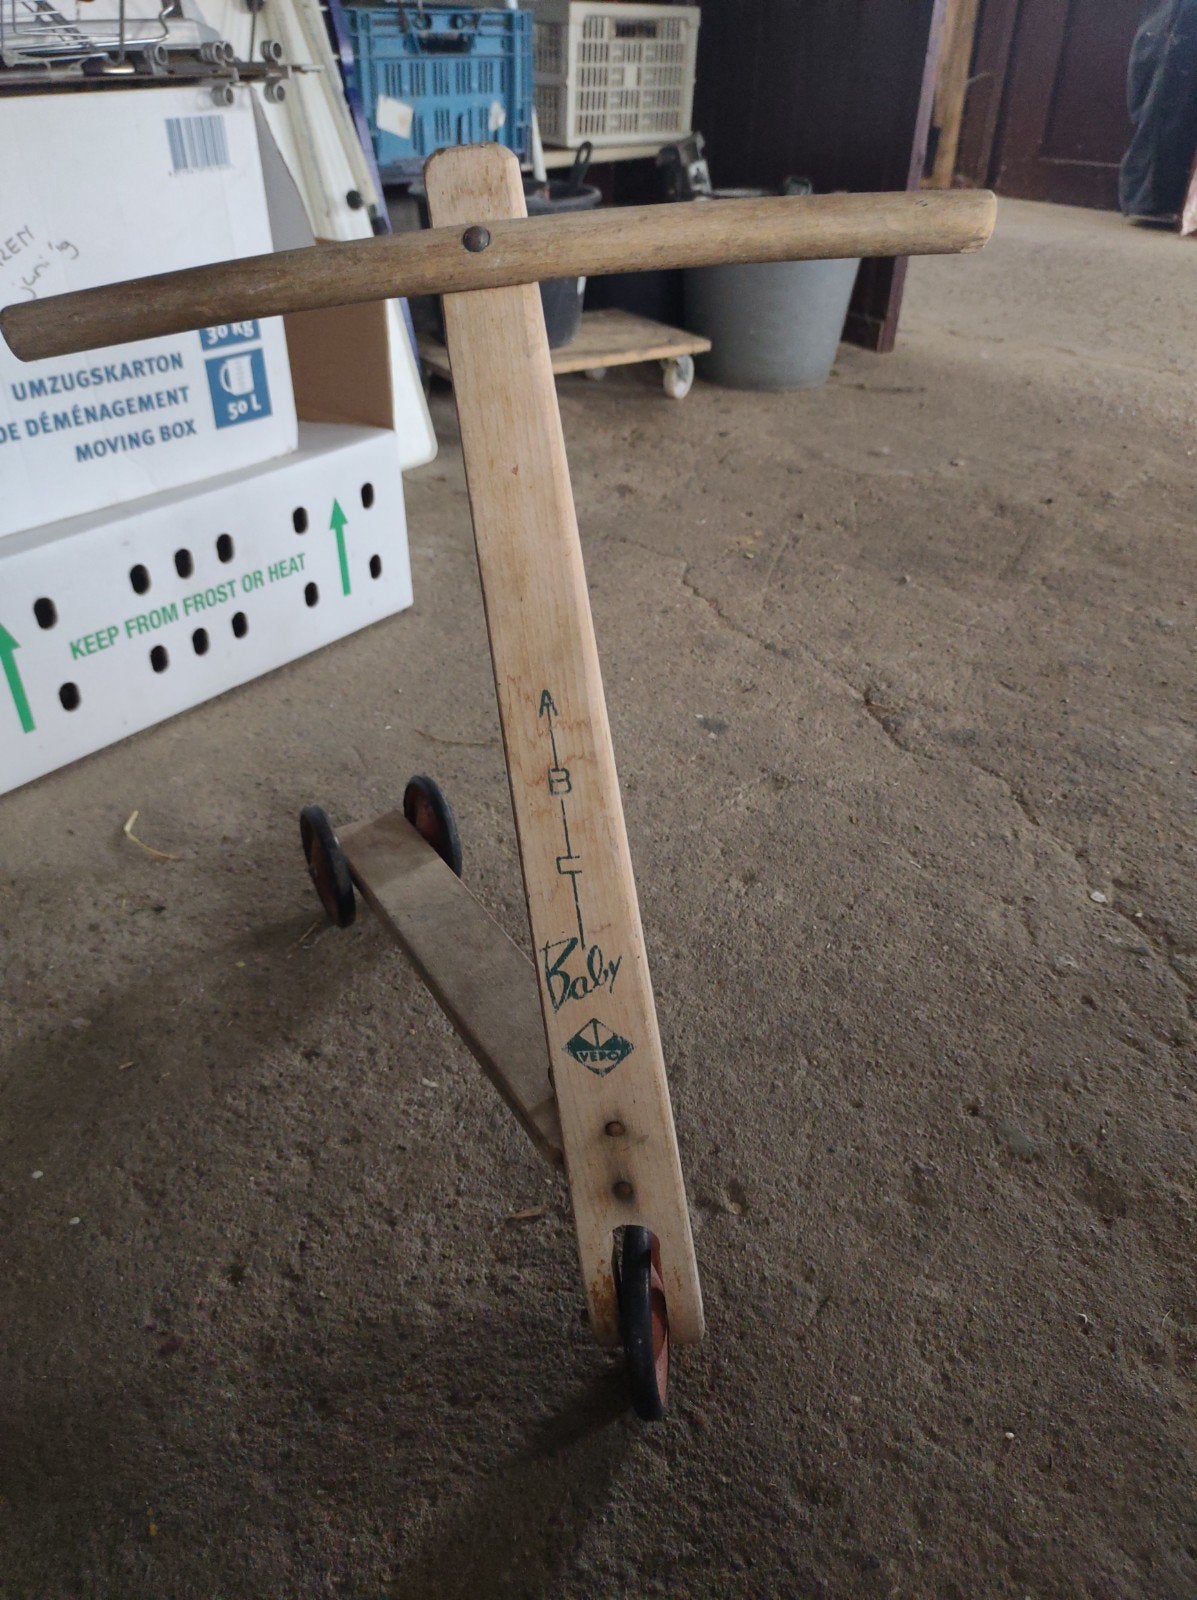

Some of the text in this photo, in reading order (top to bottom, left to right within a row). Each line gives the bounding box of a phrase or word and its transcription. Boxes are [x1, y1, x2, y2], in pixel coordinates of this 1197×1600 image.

[206, 324, 229, 345] 30
[11, 352, 184, 402] UMZUGSKARTON
[24, 385, 190, 438] DÉMÉNAGEMENT
[227, 394, 262, 421] 50 L
[74, 418, 198, 463] MOVING BOX
[69, 552, 307, 660] KEEP FROM FROST OR HEAT
[539, 689, 559, 718] A
[548, 767, 573, 796] B
[539, 936, 623, 1014] Baby
